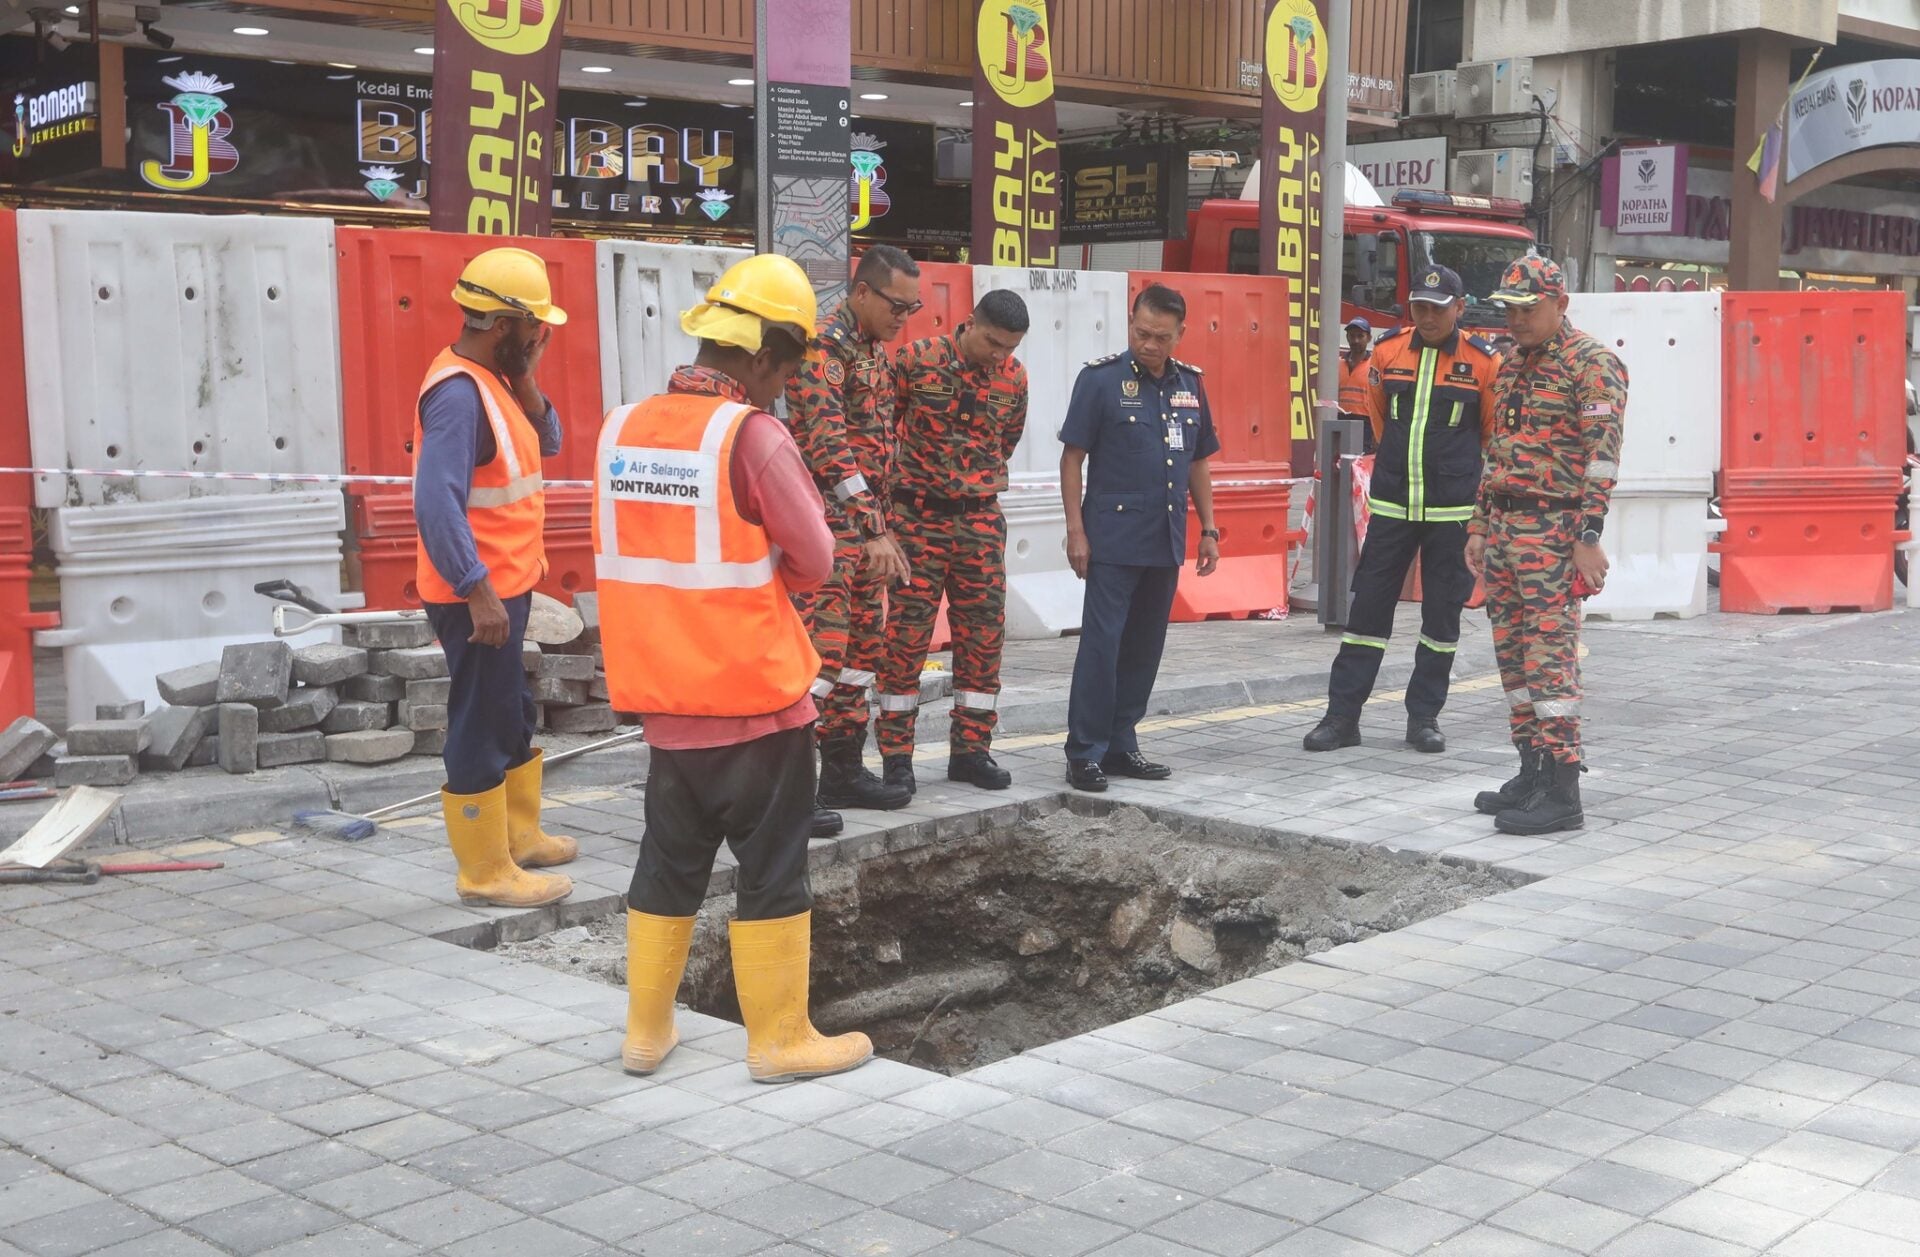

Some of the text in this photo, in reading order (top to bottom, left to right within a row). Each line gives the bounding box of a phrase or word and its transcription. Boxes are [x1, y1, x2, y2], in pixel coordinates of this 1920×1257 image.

[357, 80, 400, 96] Kedai
[1379, 79, 1395, 92] BHD.
[29, 81, 88, 128] BOMBAY
[31, 119, 88, 145] JEWELLERY
[1074, 162, 1158, 199] SH
[1622, 198, 1668, 211] KOPATHA
[1619, 211, 1670, 227] JEWELLERS
[1029, 270, 1077, 291] DBKL JKAWS
[629, 462, 699, 480] Air Selangor
[610, 479, 699, 498] KONTRAKTOR
